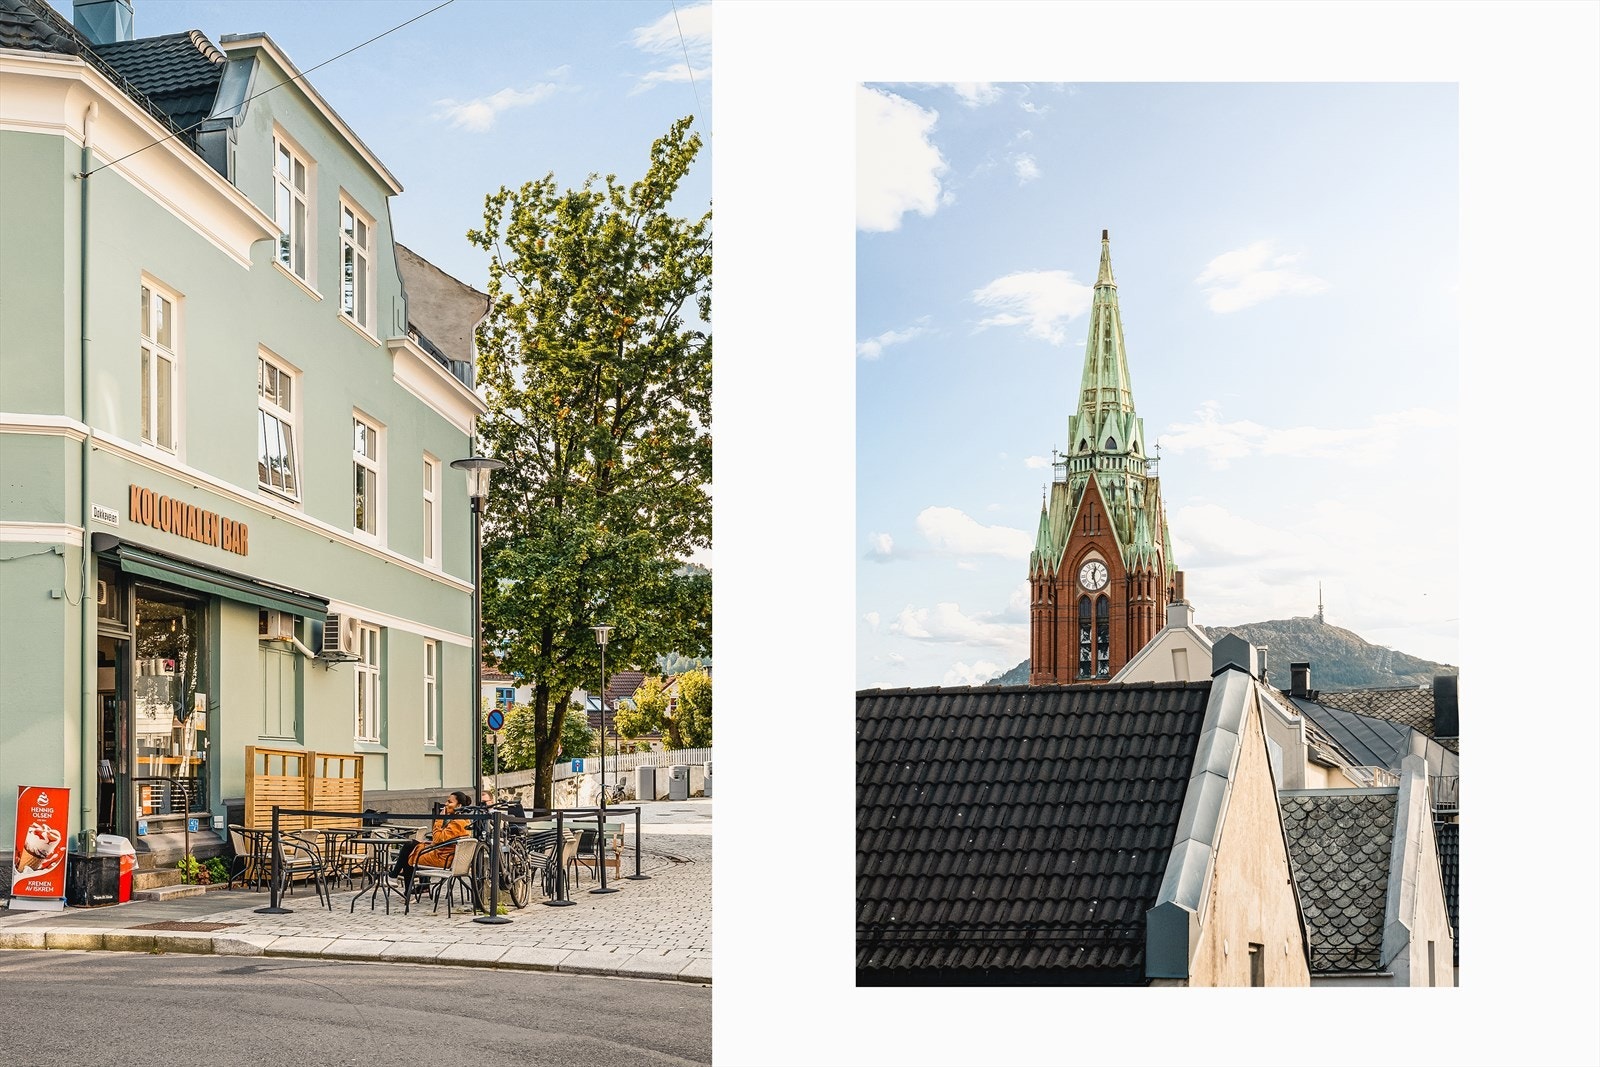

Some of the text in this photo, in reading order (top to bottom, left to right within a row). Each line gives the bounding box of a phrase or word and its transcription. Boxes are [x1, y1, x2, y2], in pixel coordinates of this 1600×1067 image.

[93, 506, 118, 524] Dokkeveien
[129, 483, 249, 557] KOLONIALEN BAR
